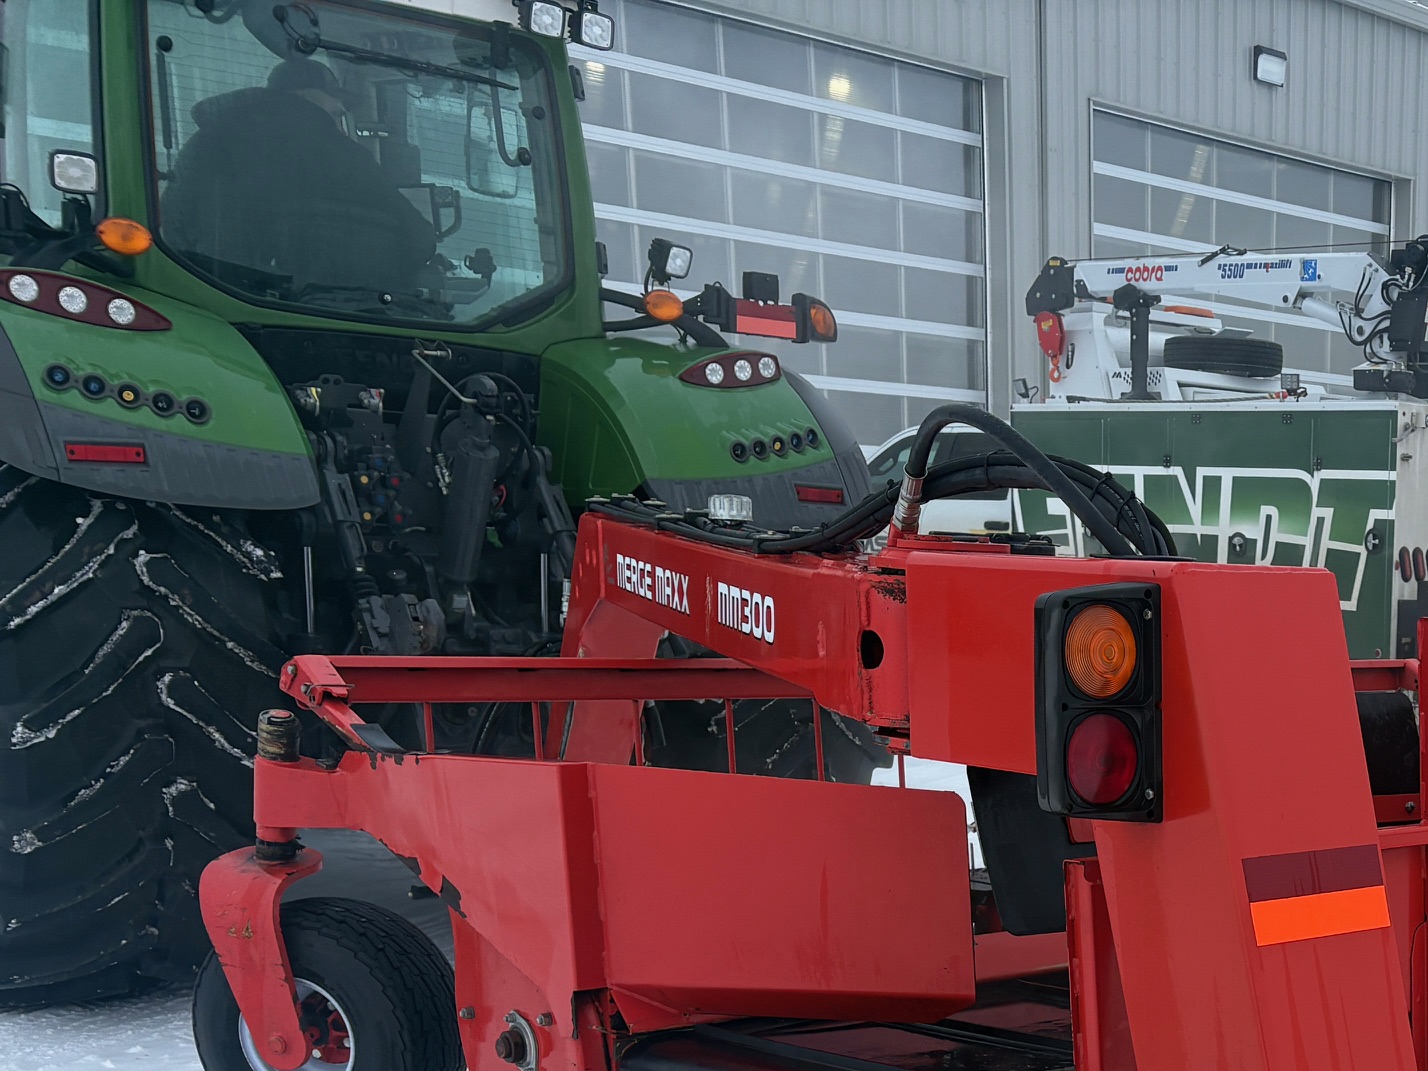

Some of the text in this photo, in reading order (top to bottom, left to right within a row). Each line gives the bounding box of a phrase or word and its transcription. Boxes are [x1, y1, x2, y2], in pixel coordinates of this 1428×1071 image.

[1125, 263, 1164, 282] cobra
[1221, 263, 1246, 279] 5500
[616, 552, 690, 616] MERGE MAXX
[716, 580, 775, 645] MM300
